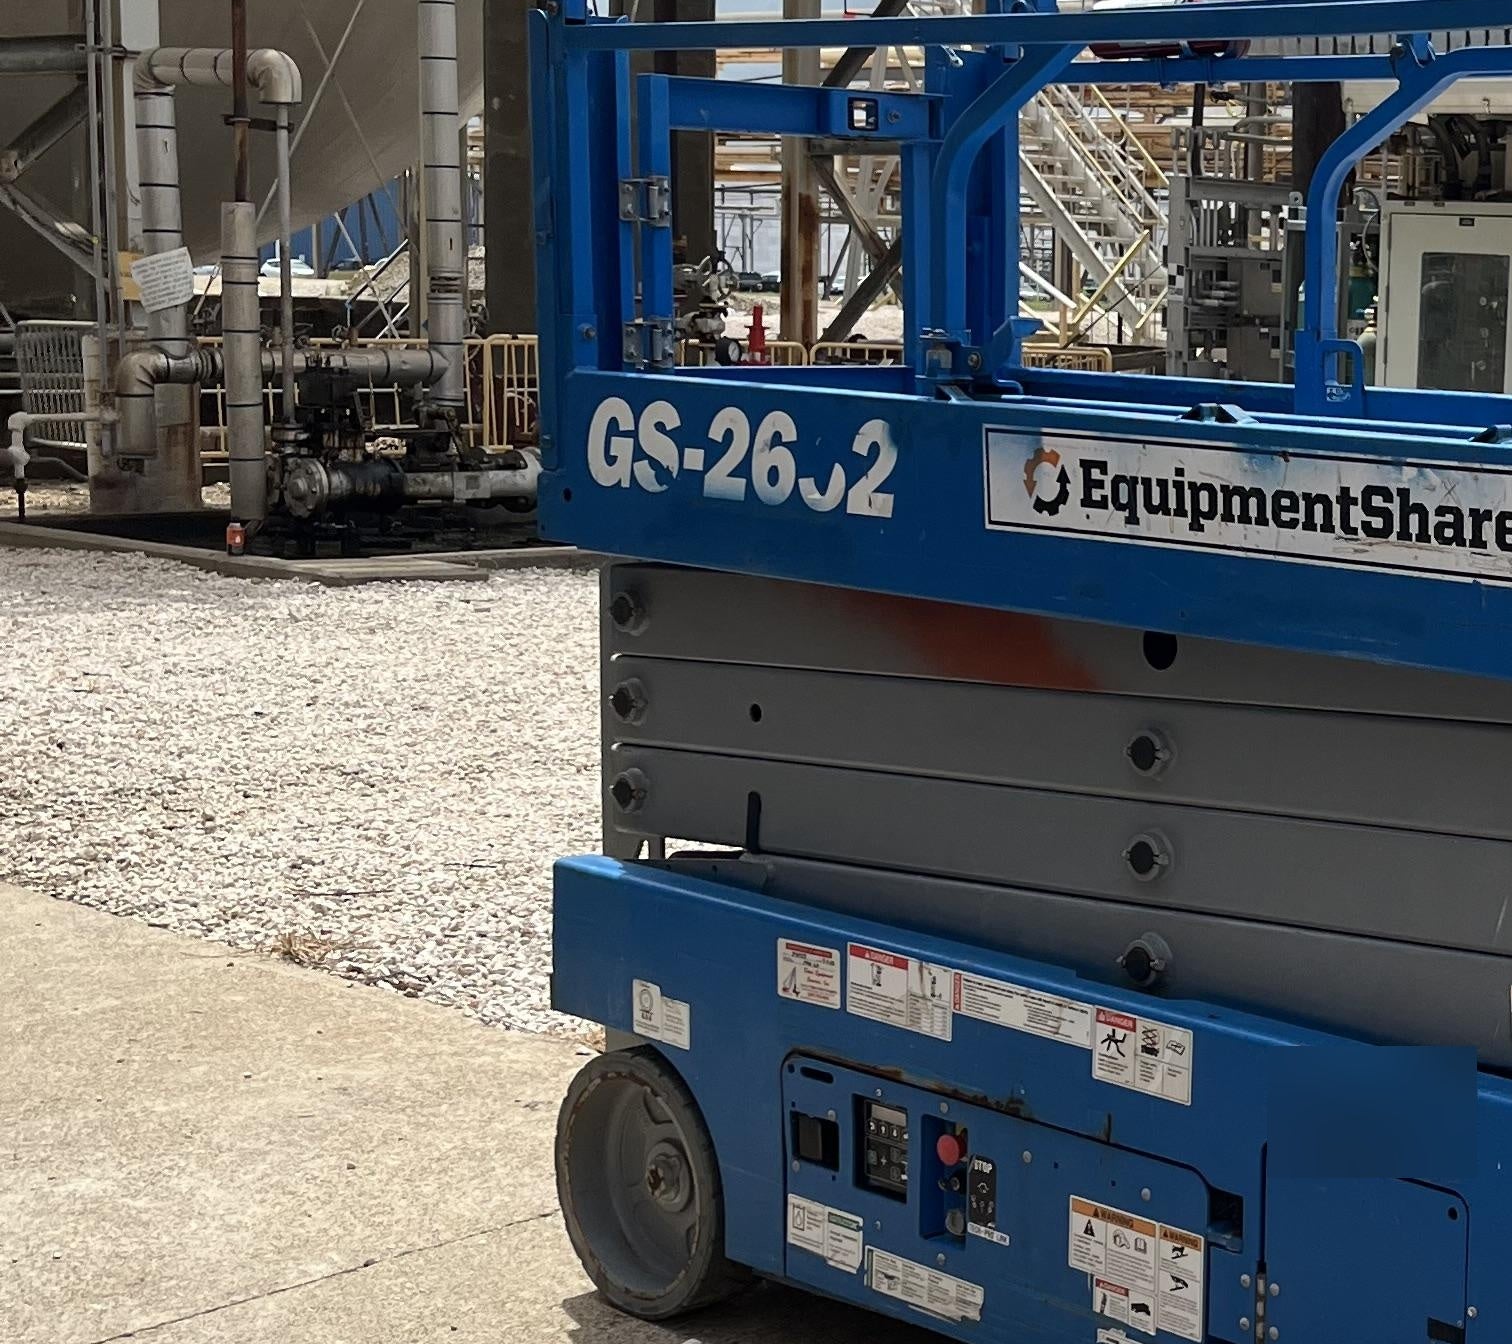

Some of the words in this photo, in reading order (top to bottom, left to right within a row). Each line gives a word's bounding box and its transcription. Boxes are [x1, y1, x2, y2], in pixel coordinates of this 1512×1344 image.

[1105, 1011, 1133, 1028] DANGER
[974, 1159, 993, 1173] STOP
[1100, 1209, 1134, 1228] WARNING
[1169, 1231, 1198, 1247] WARNING
